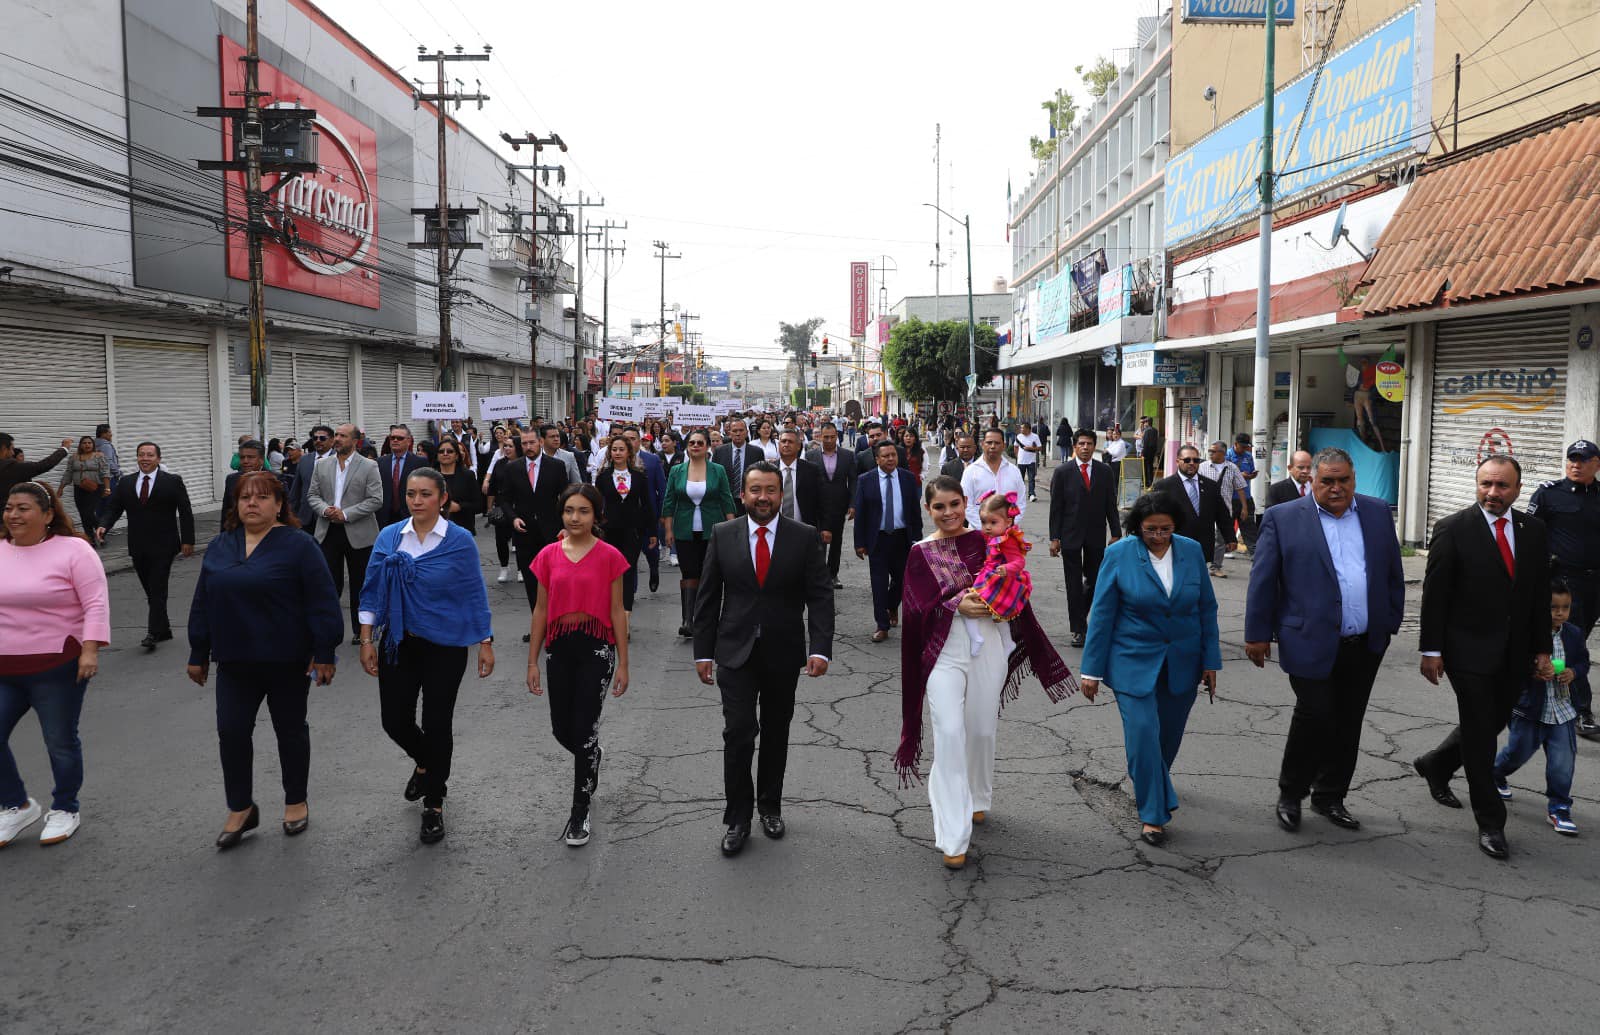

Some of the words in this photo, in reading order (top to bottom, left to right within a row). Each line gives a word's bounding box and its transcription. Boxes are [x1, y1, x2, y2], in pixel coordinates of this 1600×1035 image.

[1193, 0, 1288, 15] Molinio
[1308, 37, 1411, 129] Popular
[1305, 93, 1409, 184] Molinito
[1444, 367, 1557, 394] carreiro
